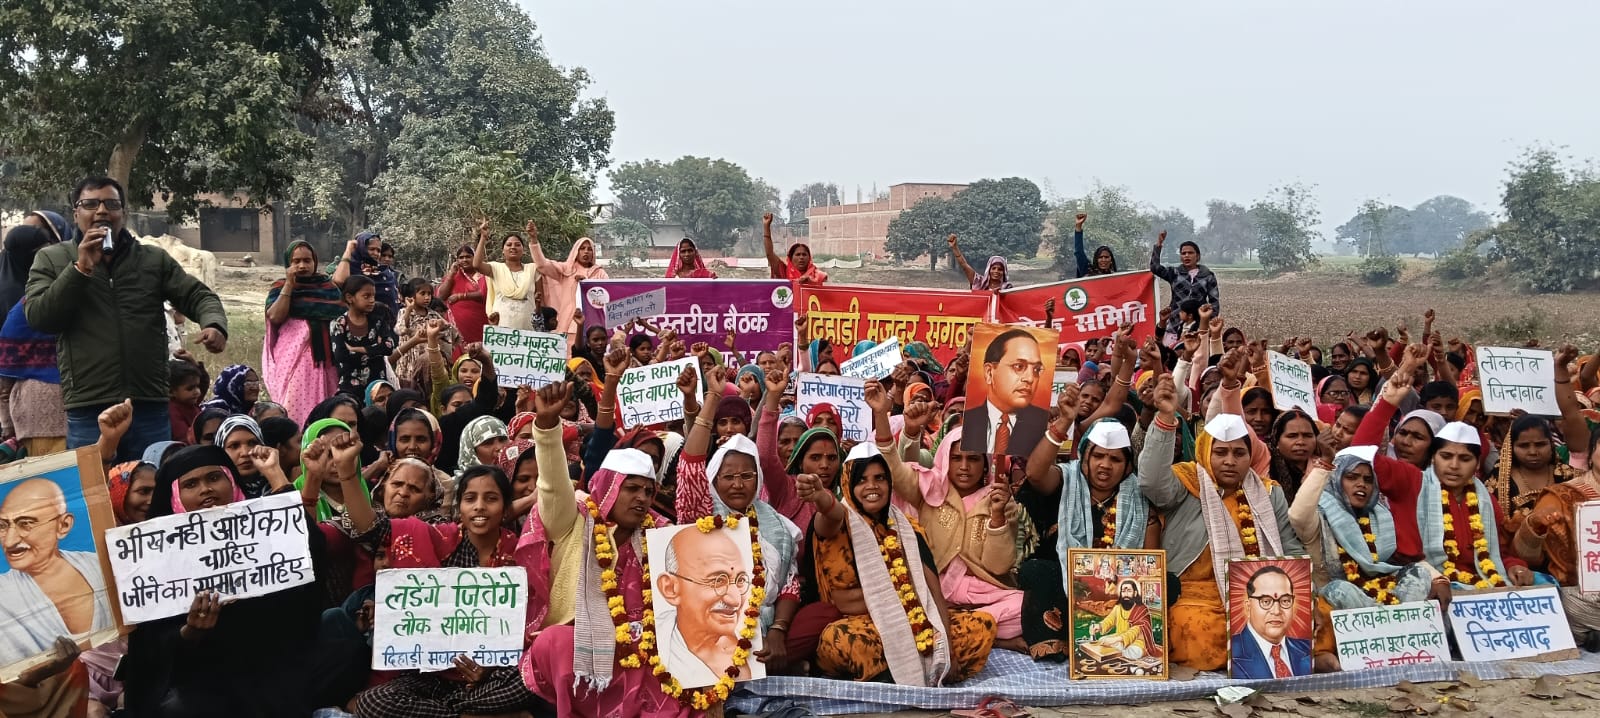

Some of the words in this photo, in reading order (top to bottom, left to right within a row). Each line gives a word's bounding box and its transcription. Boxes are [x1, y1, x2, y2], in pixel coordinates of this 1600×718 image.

[723, 304, 771, 333] बैठक
[1073, 300, 1148, 333] समिति
[651, 364, 680, 380] RAM
[619, 387, 645, 406] बिल
[646, 382, 678, 401] वापस
[199, 542, 259, 570] चाहिए
[249, 552, 305, 587] चाहिए
[393, 611, 432, 636] लोक
[441, 609, 492, 636] समिति
[1333, 614, 1351, 634] हर
[1392, 608, 1421, 623] काम
[1339, 639, 1369, 658] काम
[1369, 637, 1385, 653] का
